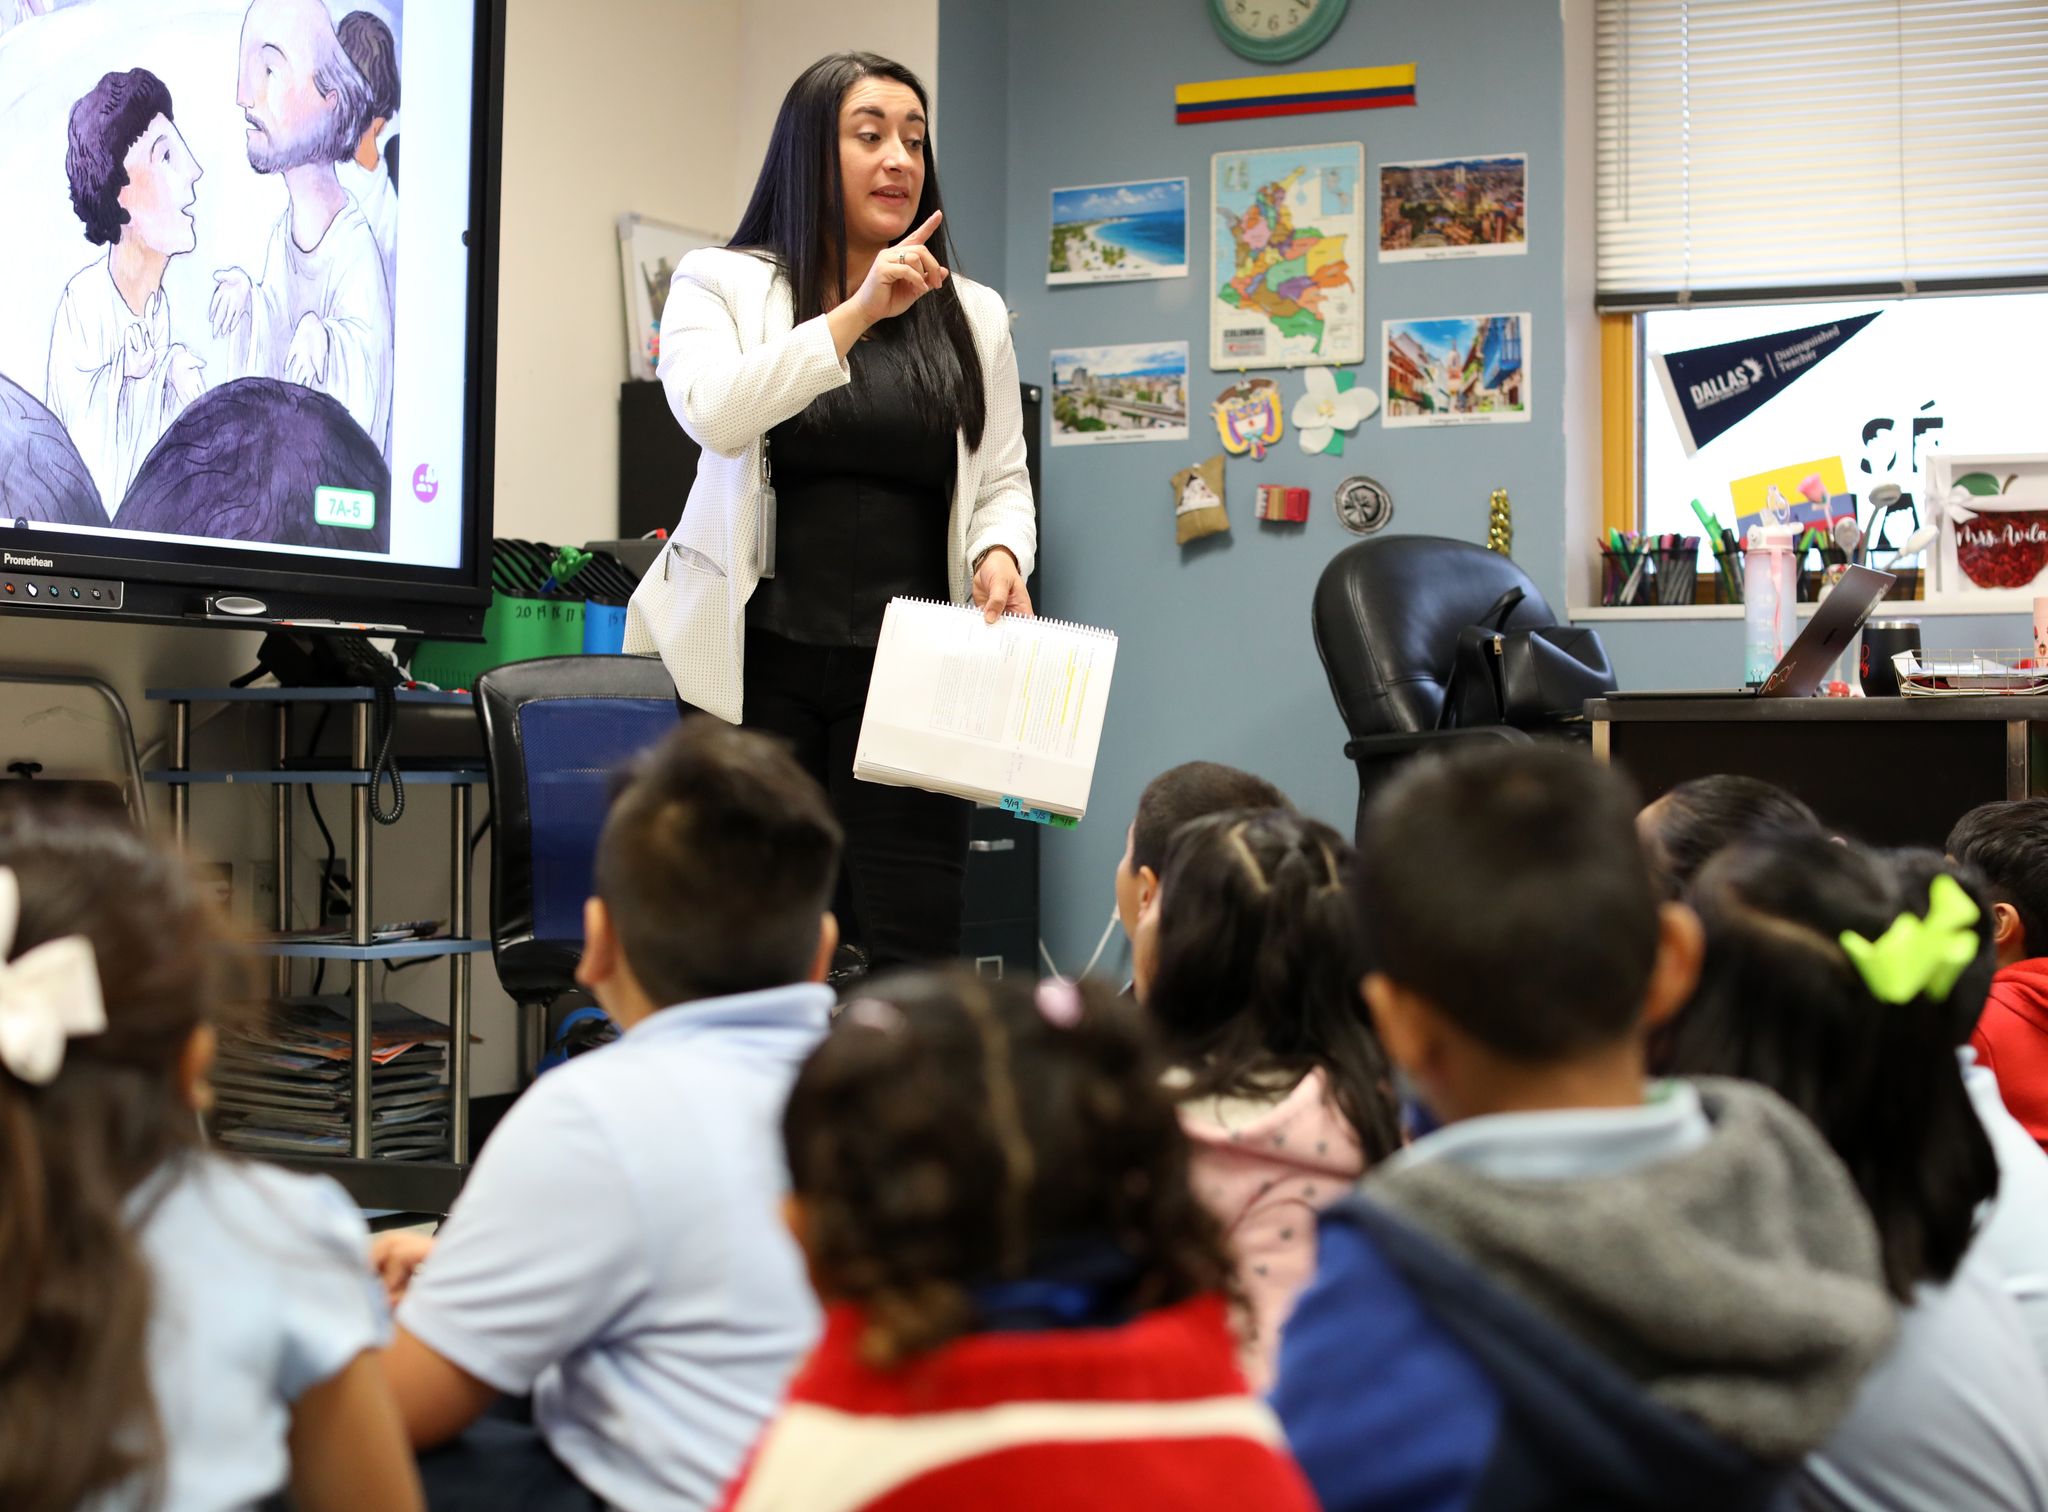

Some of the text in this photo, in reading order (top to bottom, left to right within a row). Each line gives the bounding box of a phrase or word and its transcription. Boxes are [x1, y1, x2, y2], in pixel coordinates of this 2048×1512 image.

[1267, 14, 1280, 32] 6
[1689, 366, 1750, 406] DALLAS
[329, 497, 361, 519] 7A-5
[3, 552, 54, 568] Promethean
[515, 605, 532, 619] 20
[1003, 797, 1020, 810] 9/19
